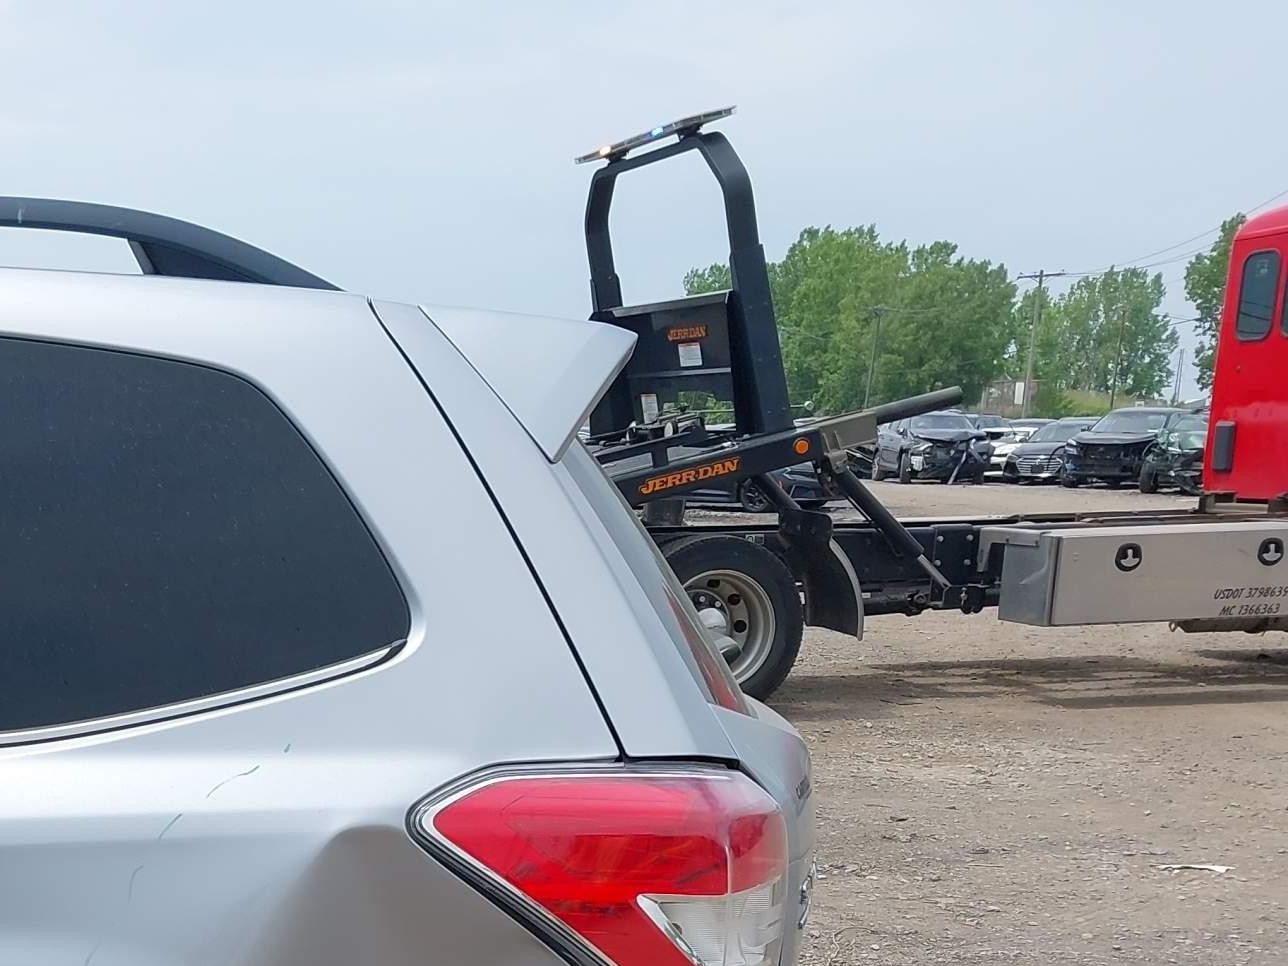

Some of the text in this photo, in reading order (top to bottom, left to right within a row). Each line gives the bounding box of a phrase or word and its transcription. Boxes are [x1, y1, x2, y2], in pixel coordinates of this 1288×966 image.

[1214, 588, 1245, 600] USDOT
[1219, 603, 1280, 616] MC 1366363
